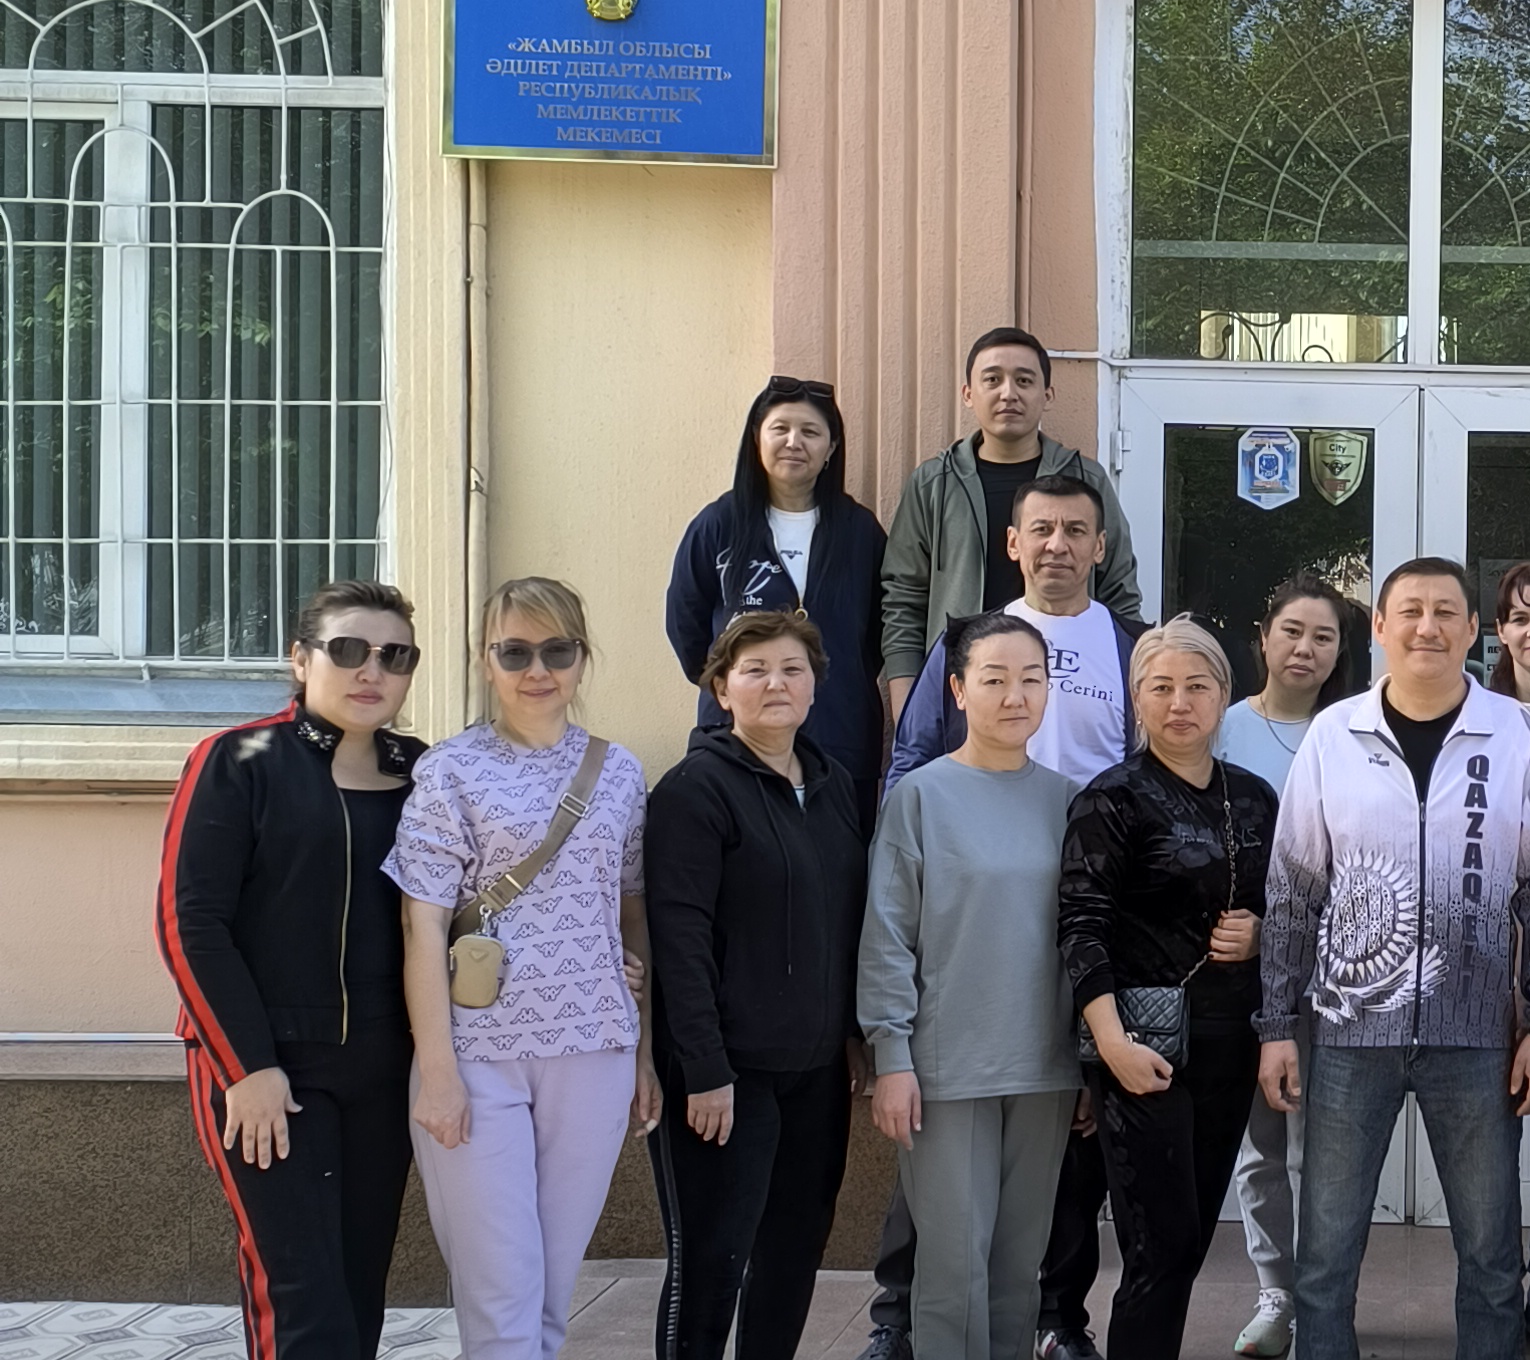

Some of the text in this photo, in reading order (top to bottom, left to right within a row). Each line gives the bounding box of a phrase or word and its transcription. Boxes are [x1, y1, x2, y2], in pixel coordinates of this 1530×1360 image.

[508, 37, 712, 59] «ЖАМБЫЛ ОБЛЫСЫ
[485, 58, 733, 82] ӘДІЛЕТ ДЕПАРТАМЕНТІ»
[518, 81, 702, 105] РЕСПУБЛИКАЛЫҚ
[536, 103, 682, 124] МЕМЛЕКЕТТІК
[556, 126, 662, 145] МЕКЕМЕСІ
[1329, 443, 1347, 454] City
[1059, 679, 1114, 703] Cerini
[1462, 754, 1490, 903] QAZAQ
